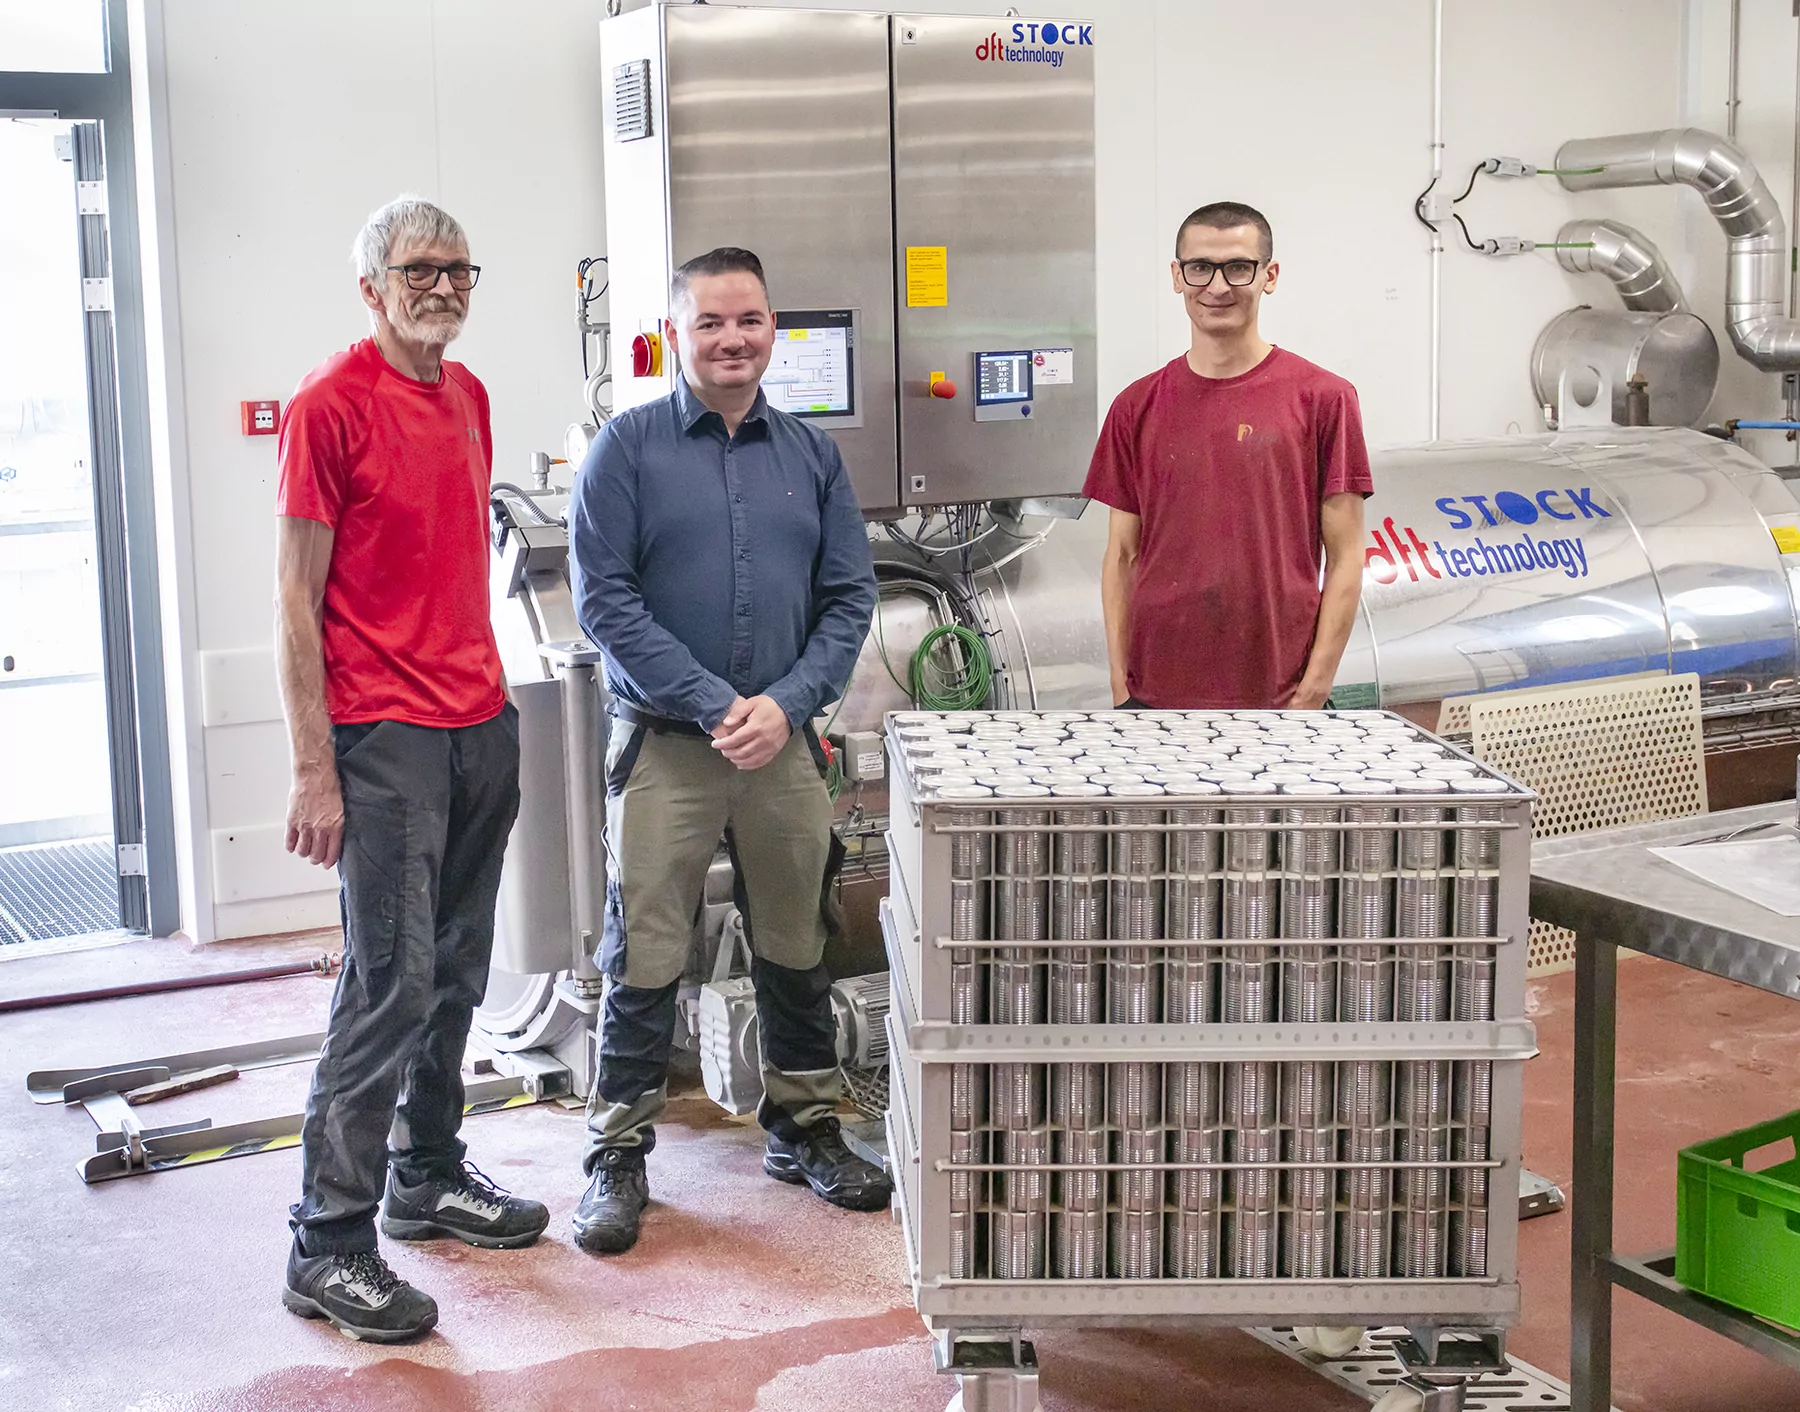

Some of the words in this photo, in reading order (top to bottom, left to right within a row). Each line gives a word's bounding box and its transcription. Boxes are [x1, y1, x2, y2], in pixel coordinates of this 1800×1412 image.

[975, 32, 1004, 61] dft
[1005, 46, 1064, 67] technology
[1012, 23, 1093, 45] STOCK
[1434, 487, 1612, 529] STOCK
[1365, 516, 1441, 584] dft
[1433, 533, 1588, 579] technology
